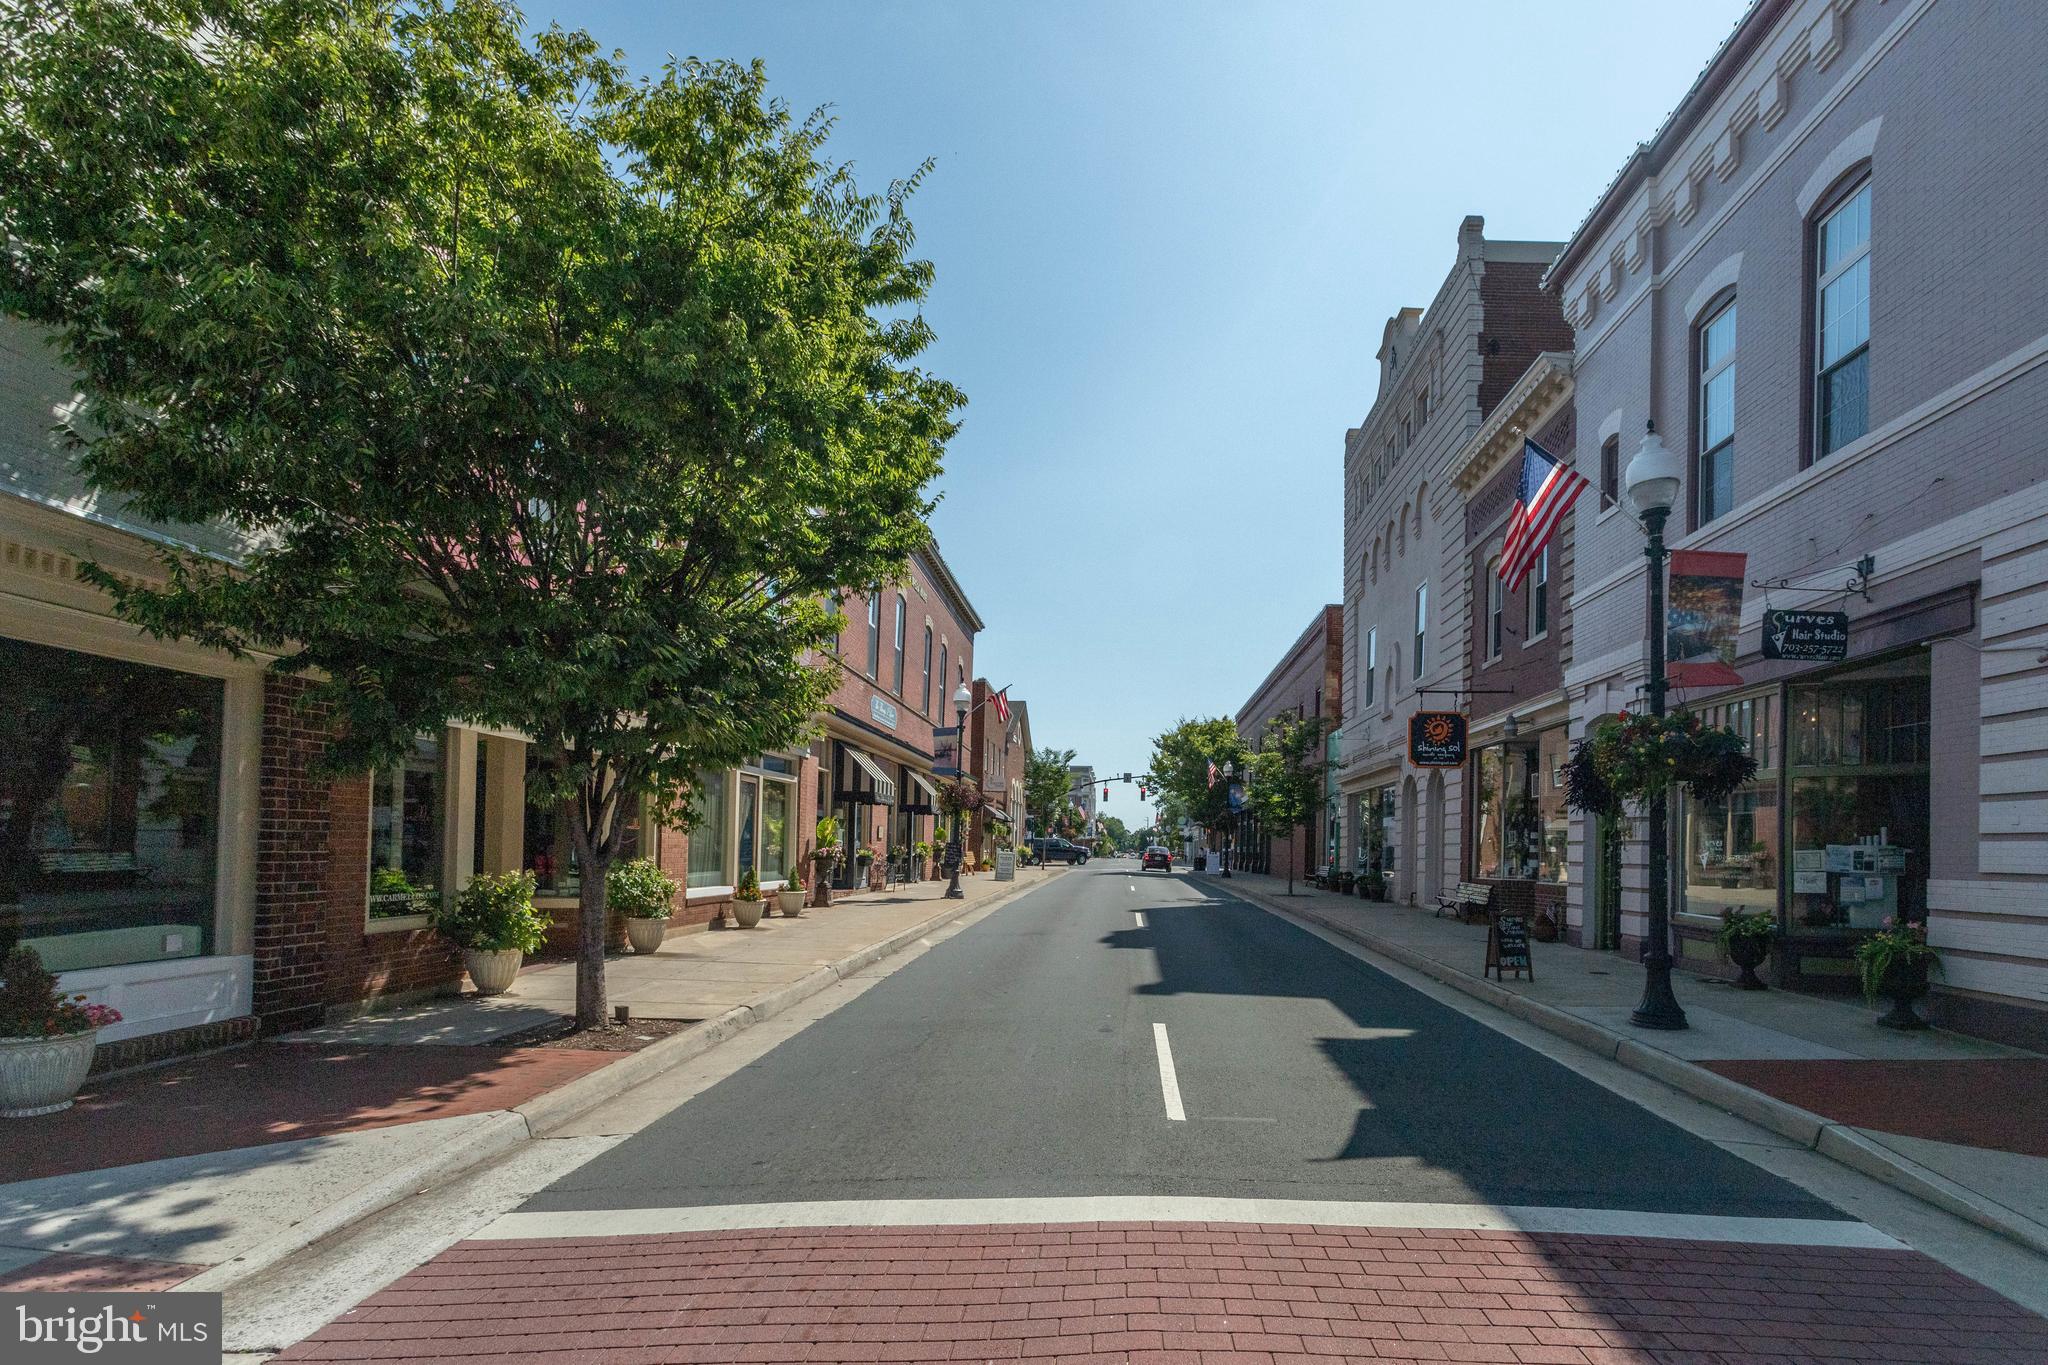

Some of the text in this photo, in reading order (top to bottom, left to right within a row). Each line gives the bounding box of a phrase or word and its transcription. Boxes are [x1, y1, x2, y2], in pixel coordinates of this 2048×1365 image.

[1772, 611, 1835, 632] Curves
[1792, 629, 1846, 640] Hair Studio
[1418, 741, 1460, 754] shining sol
[1500, 956, 1527, 967] OPEN
